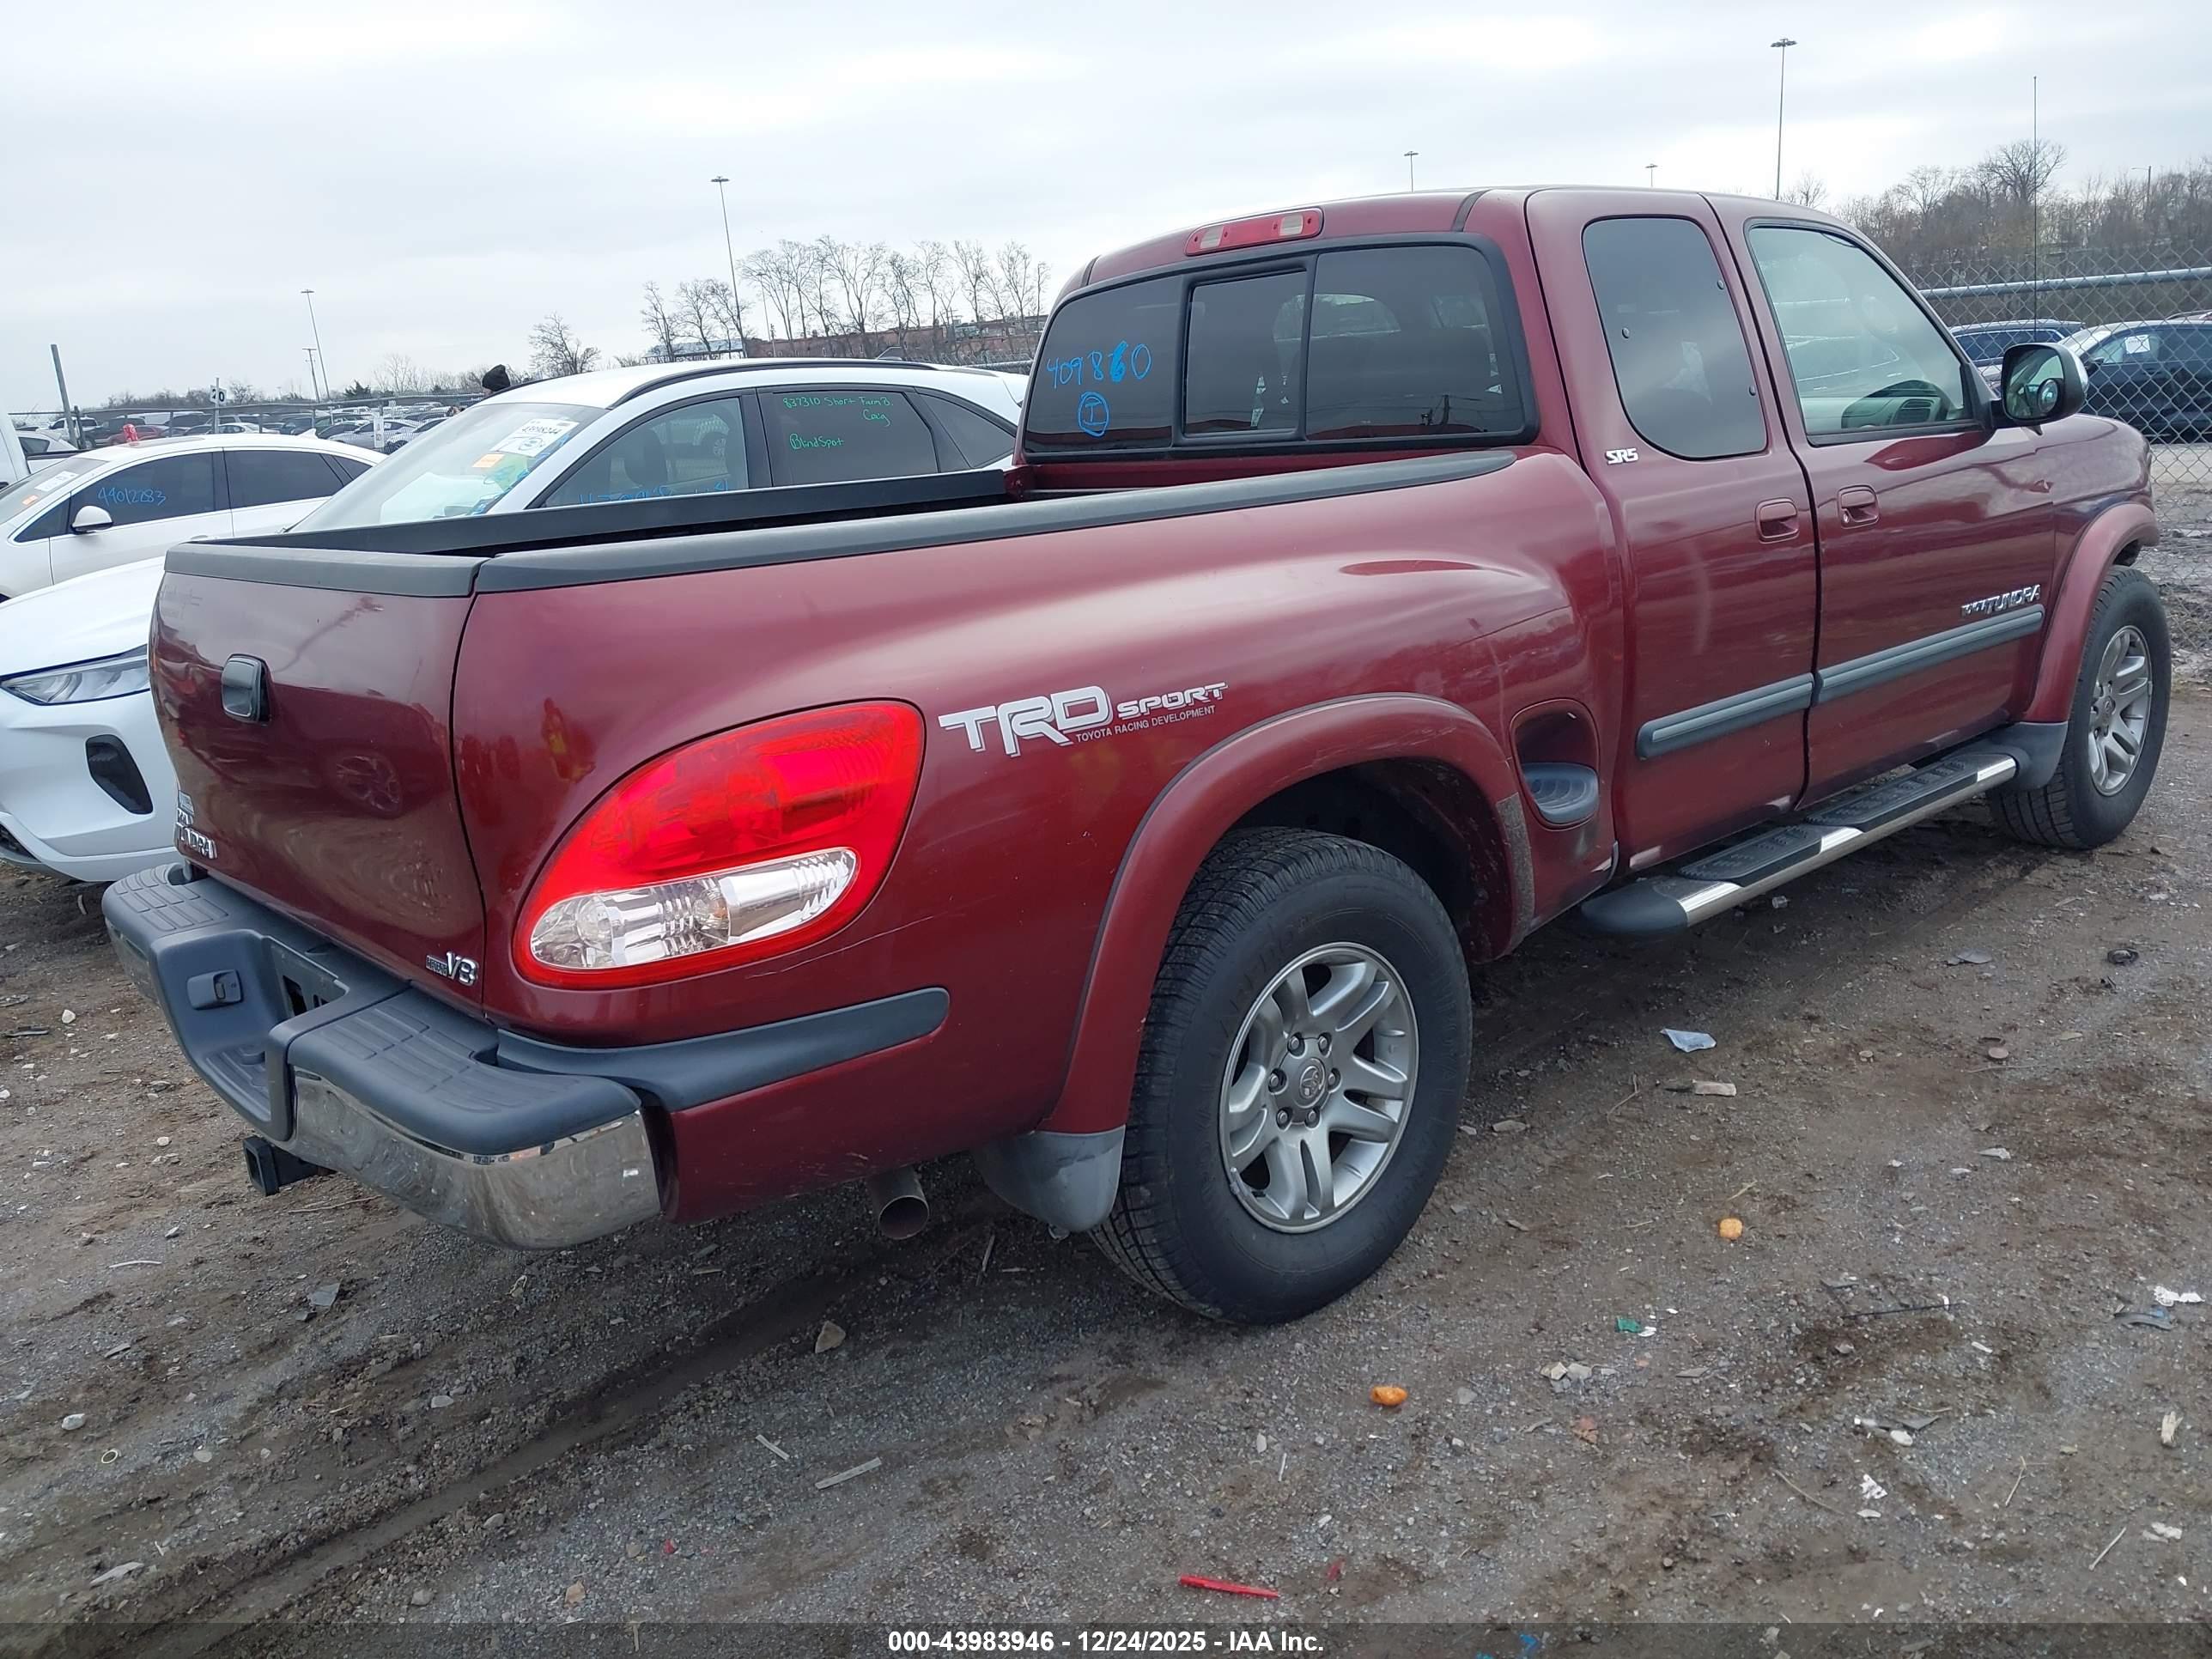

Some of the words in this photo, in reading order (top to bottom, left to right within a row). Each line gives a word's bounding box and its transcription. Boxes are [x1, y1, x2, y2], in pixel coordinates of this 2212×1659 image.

[1605, 447, 1639, 465] SR5
[938, 684, 1115, 758] TRD
[1116, 682, 1229, 721] SPORT
[1075, 728, 1113, 744] TOYOTA
[1114, 719, 1150, 735] RACING
[1152, 704, 1217, 727] DEVELOPMENT
